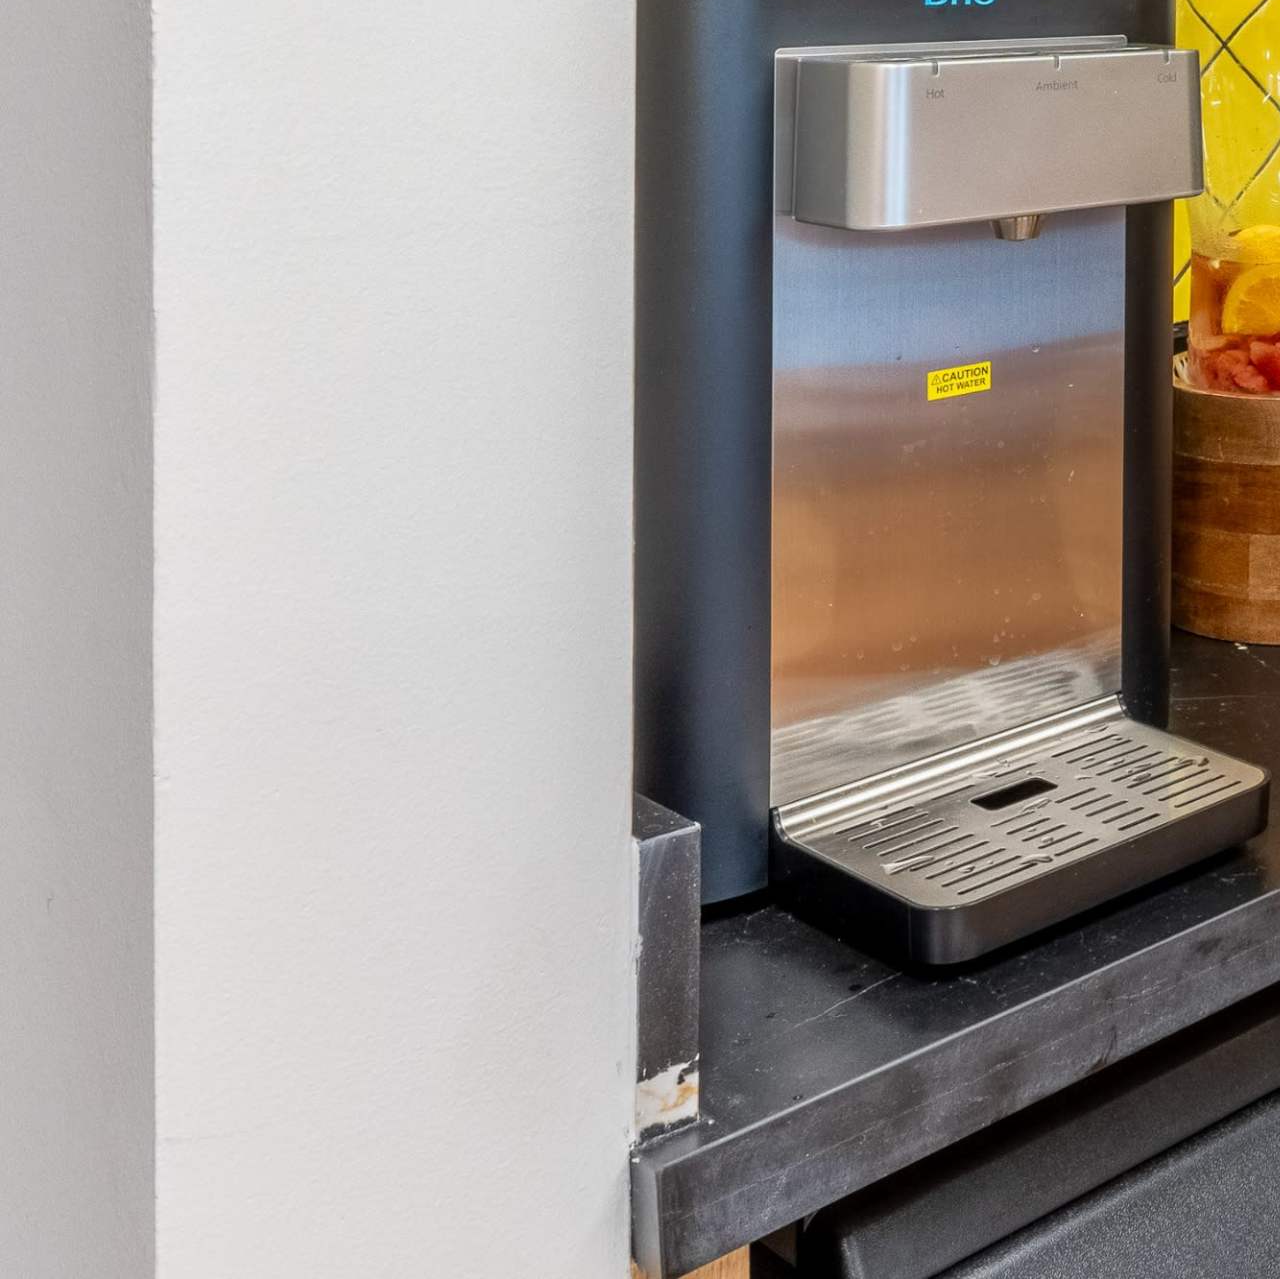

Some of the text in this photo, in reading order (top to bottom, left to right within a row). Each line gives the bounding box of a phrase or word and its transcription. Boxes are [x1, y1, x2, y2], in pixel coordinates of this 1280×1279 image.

[1157, 73, 1177, 84] Cold
[1035, 80, 1079, 92] Ambient
[926, 88, 945, 99] Hot
[942, 366, 989, 383] CAUTION
[936, 377, 986, 394] HOT WATER
